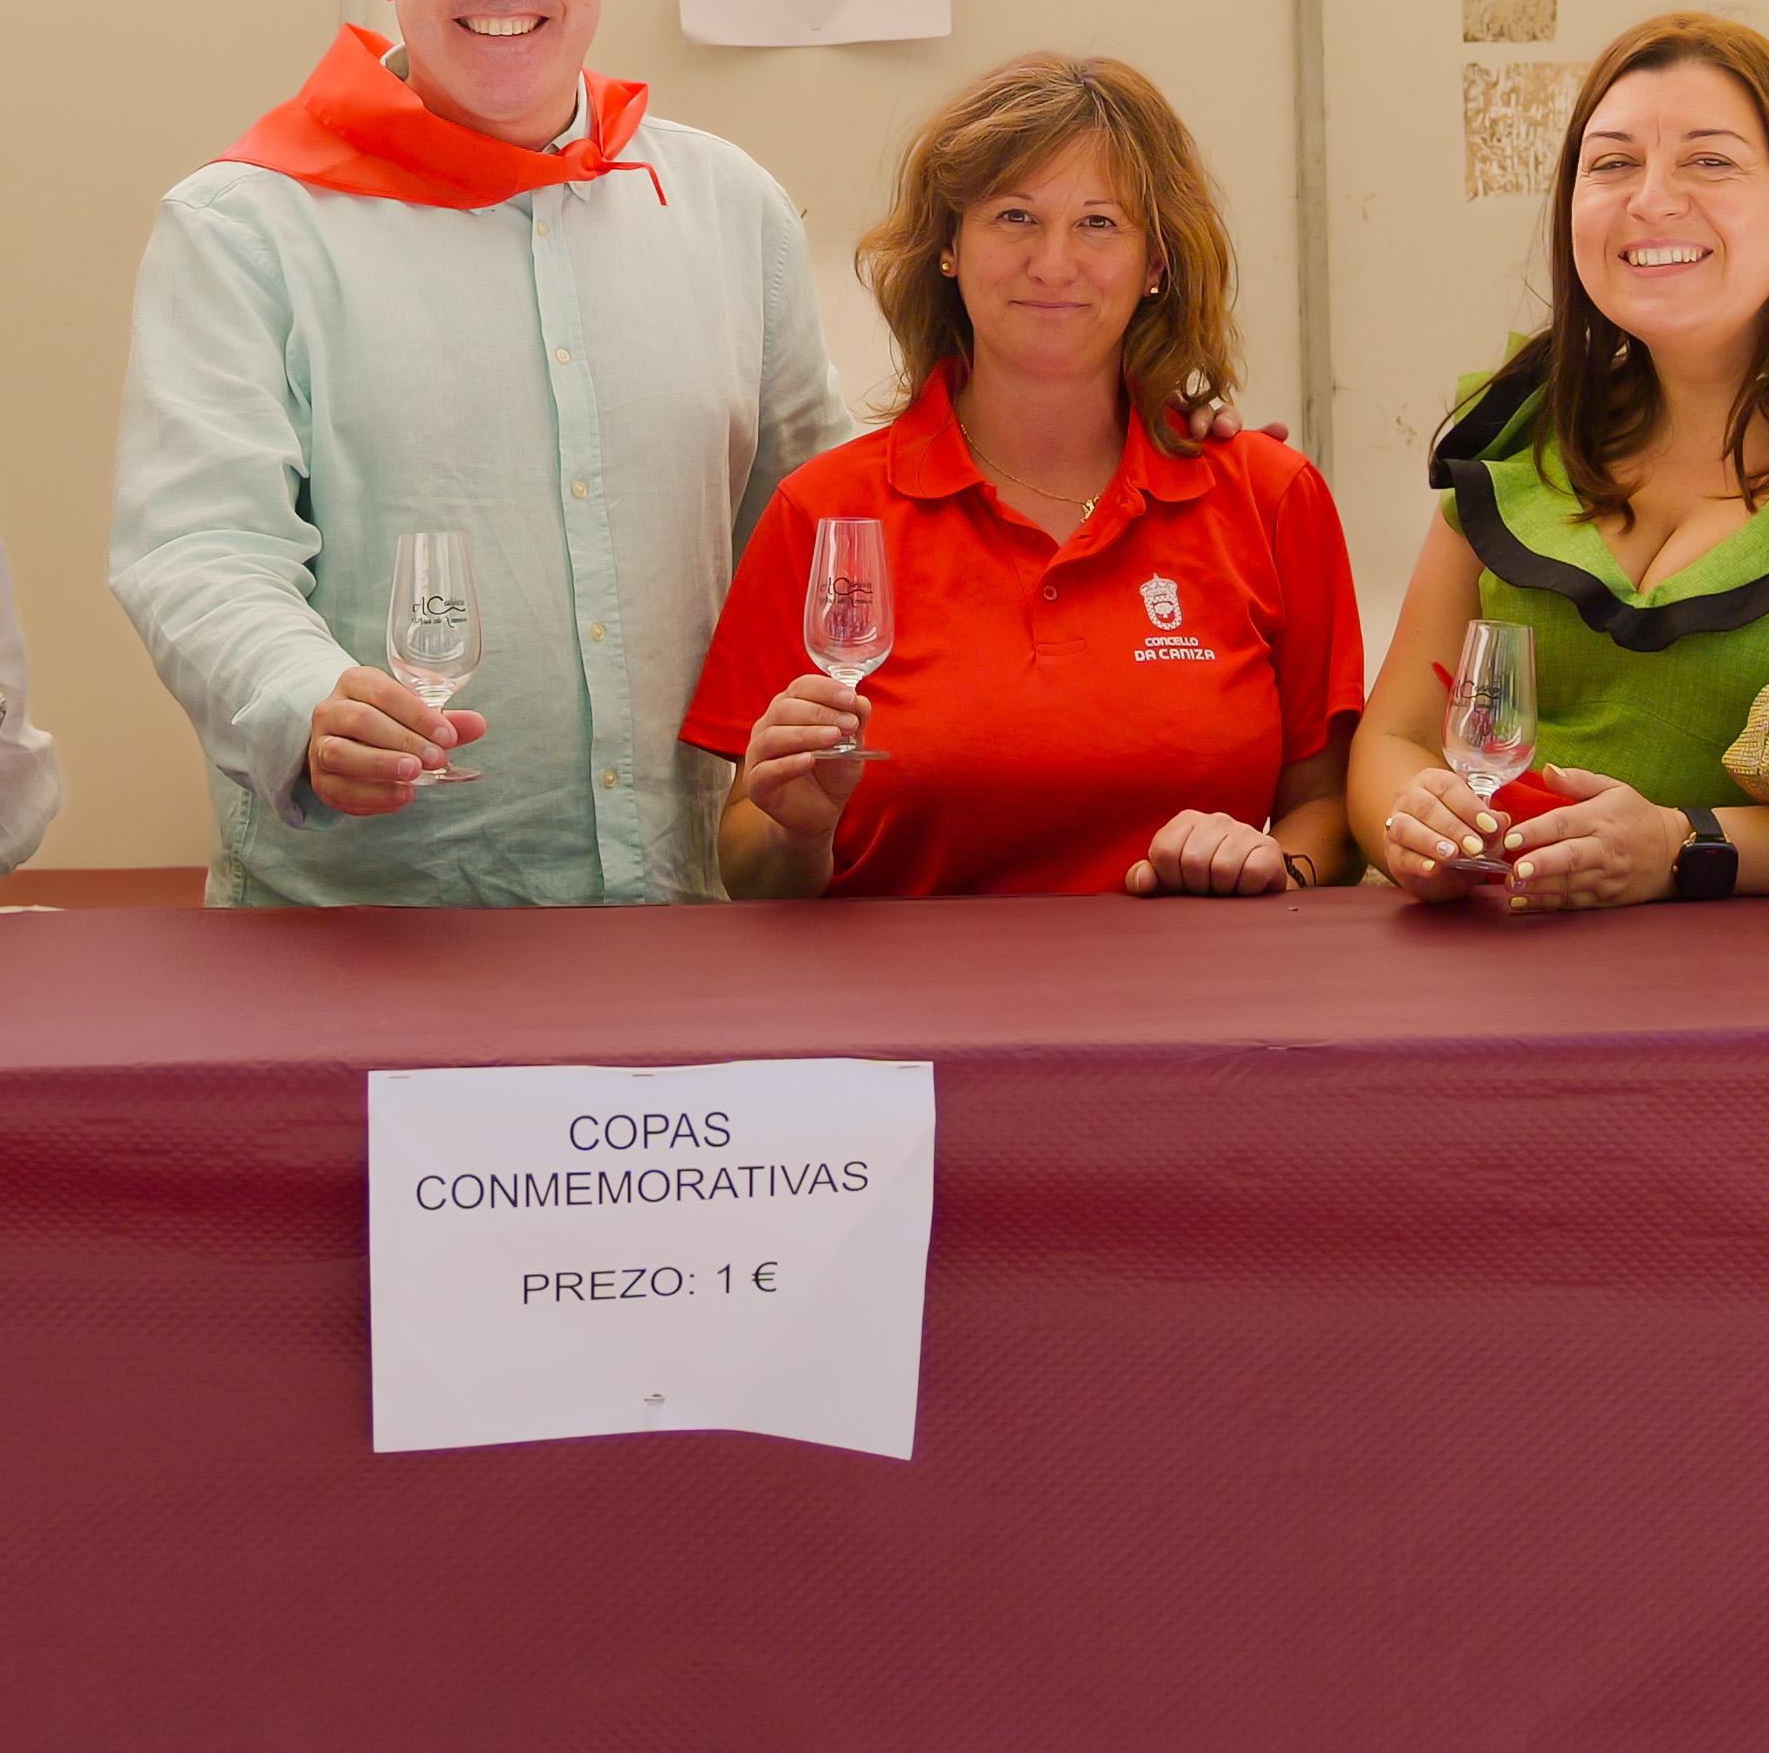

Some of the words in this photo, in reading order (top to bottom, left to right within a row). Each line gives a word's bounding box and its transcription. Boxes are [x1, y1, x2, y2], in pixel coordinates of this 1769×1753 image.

[1134, 649, 1157, 662] DA
[1144, 636, 1199, 647] CONCELLO
[569, 1111, 732, 1151] COPAS
[416, 1161, 869, 1211] CONMEMORATIVAS
[523, 1266, 696, 1305] PREZO:
[716, 1263, 732, 1294] 1
[751, 1261, 778, 1293] €
